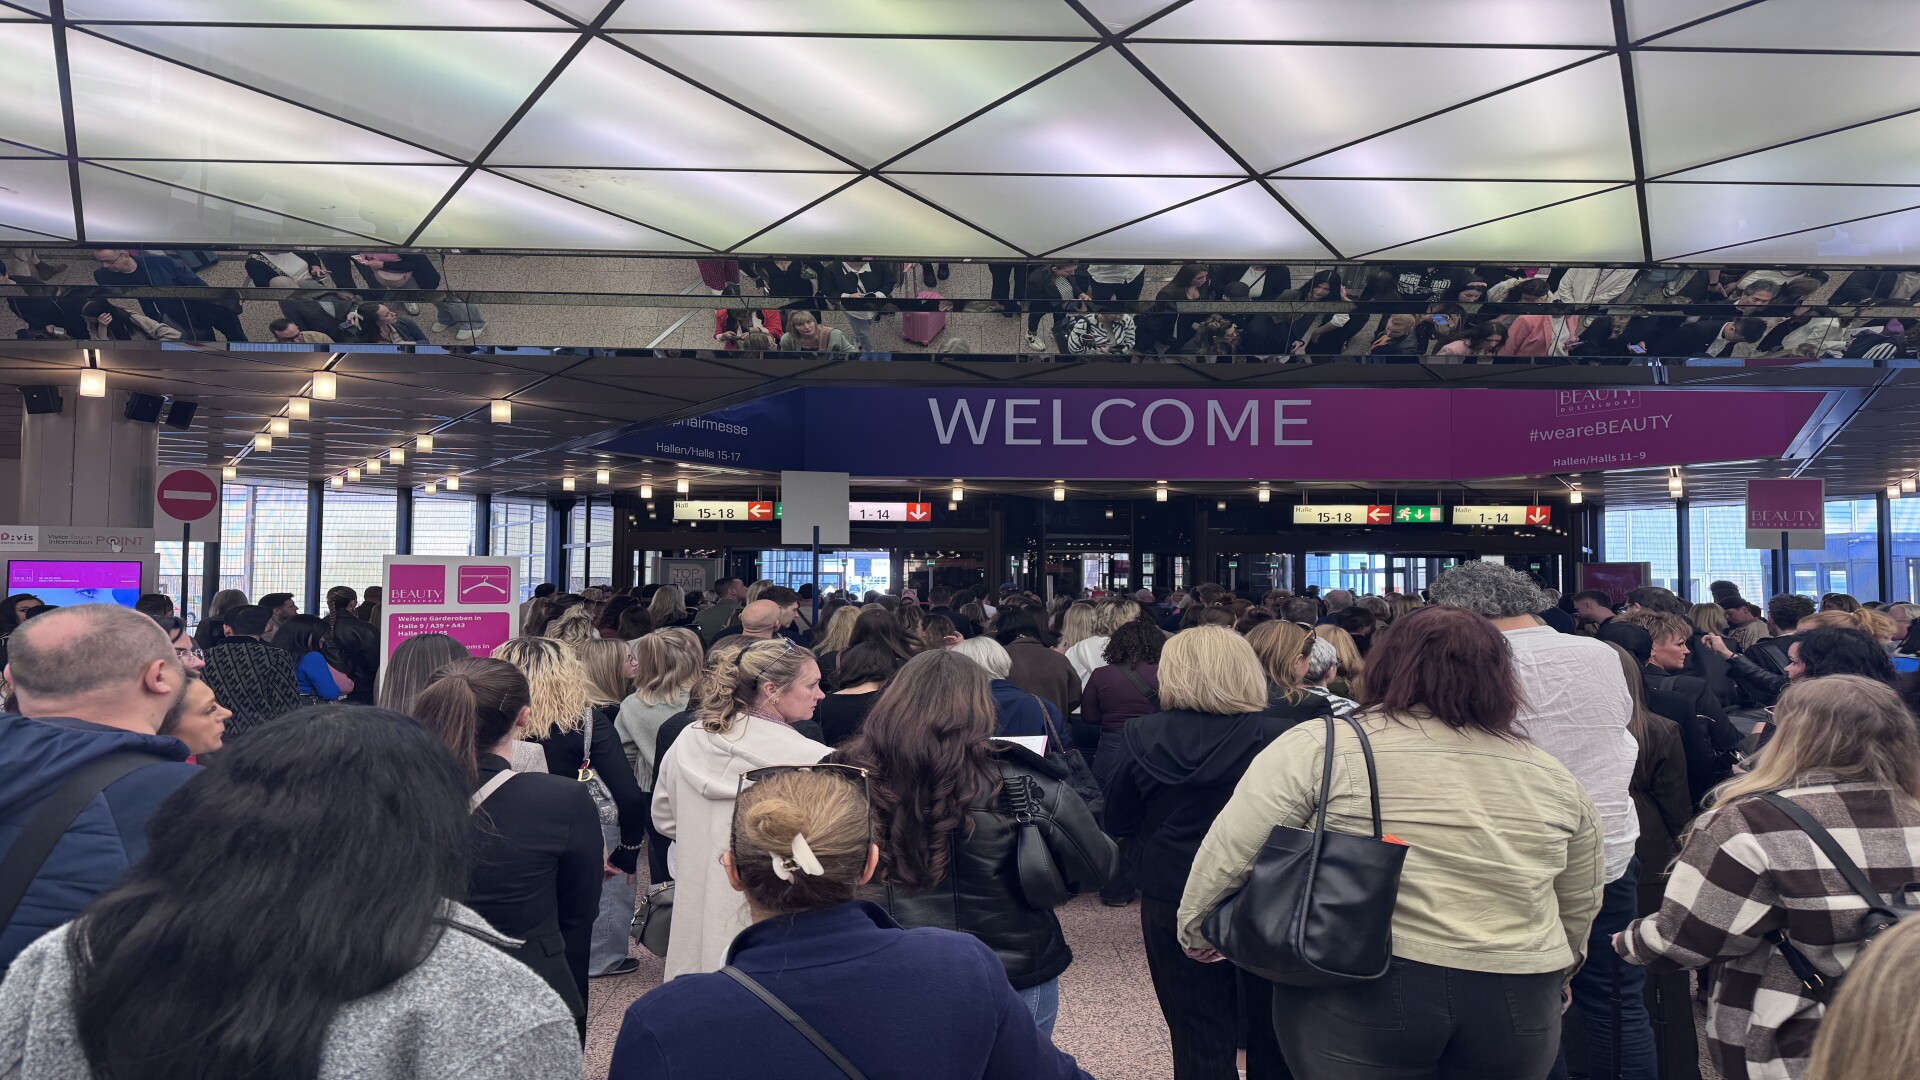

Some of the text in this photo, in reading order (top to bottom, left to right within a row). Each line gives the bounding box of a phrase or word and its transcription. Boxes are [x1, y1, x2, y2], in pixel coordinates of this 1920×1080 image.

[1560, 399, 1636, 412] DÜSSELDORF
[927, 397, 1313, 446] WELCOME
[1529, 413, 1673, 442] #weareBEAUTY
[656, 441, 741, 462] Hallen/Halls 15-17
[1553, 453, 1617, 467] Hallen/Halls
[697, 508, 735, 519] 15-18
[876, 509, 890, 519] 14
[1317, 512, 1352, 522] 15-18
[1495, 513, 1509, 523] 14
[1751, 510, 1819, 521] BEAUTY
[673, 568, 700, 579] TOP
[673, 578, 703, 588] HAIR
[391, 589, 443, 599] BEAUTY
